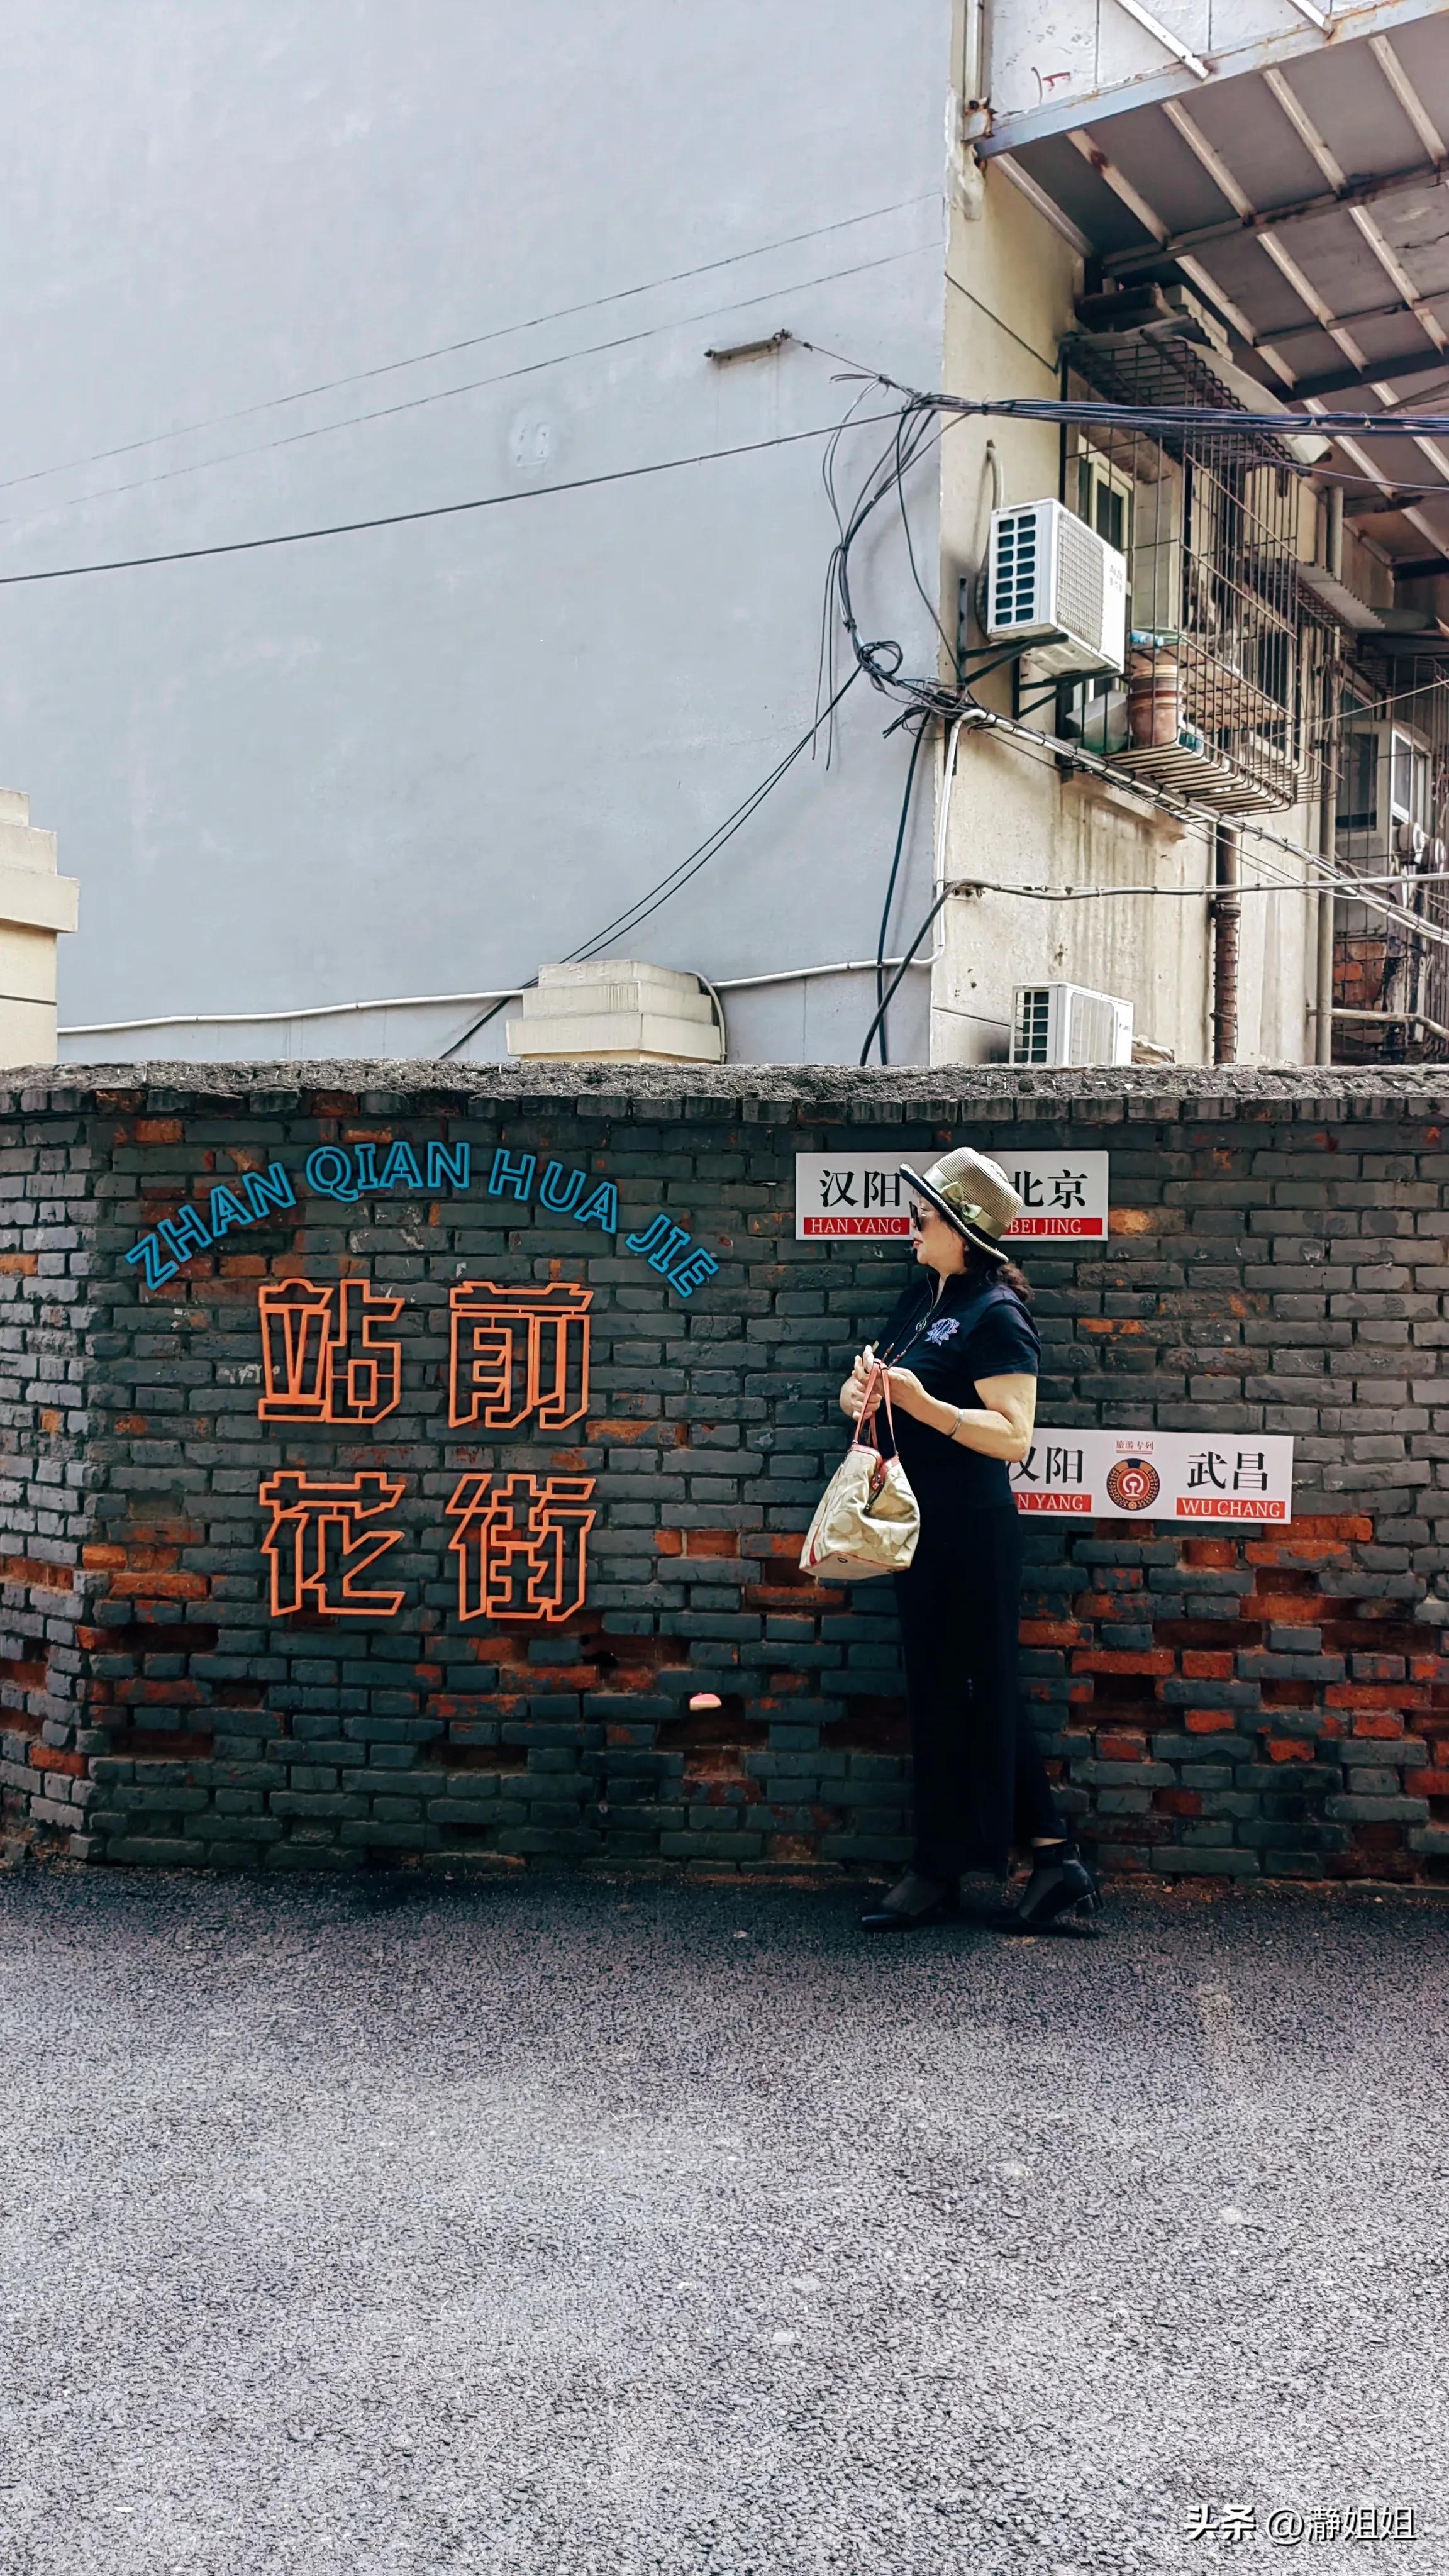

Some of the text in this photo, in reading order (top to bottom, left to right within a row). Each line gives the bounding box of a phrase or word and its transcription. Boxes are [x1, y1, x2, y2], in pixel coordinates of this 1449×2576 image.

[819, 1169, 1088, 1209] 汉阳 北京
[126, 1142, 719, 1298] ZHAN QIAN HUA JIE
[810, 1219, 1082, 1235] HAN YANG BEI JING
[258, 1278, 593, 1430] 站前
[1187, 1450, 1269, 1491] 武昌
[1034, 1494, 1084, 1511] YANG
[1182, 1499, 1212, 1516] WU
[1217, 1501, 1281, 1518] CHANG
[258, 1470, 596, 1622] 花街
